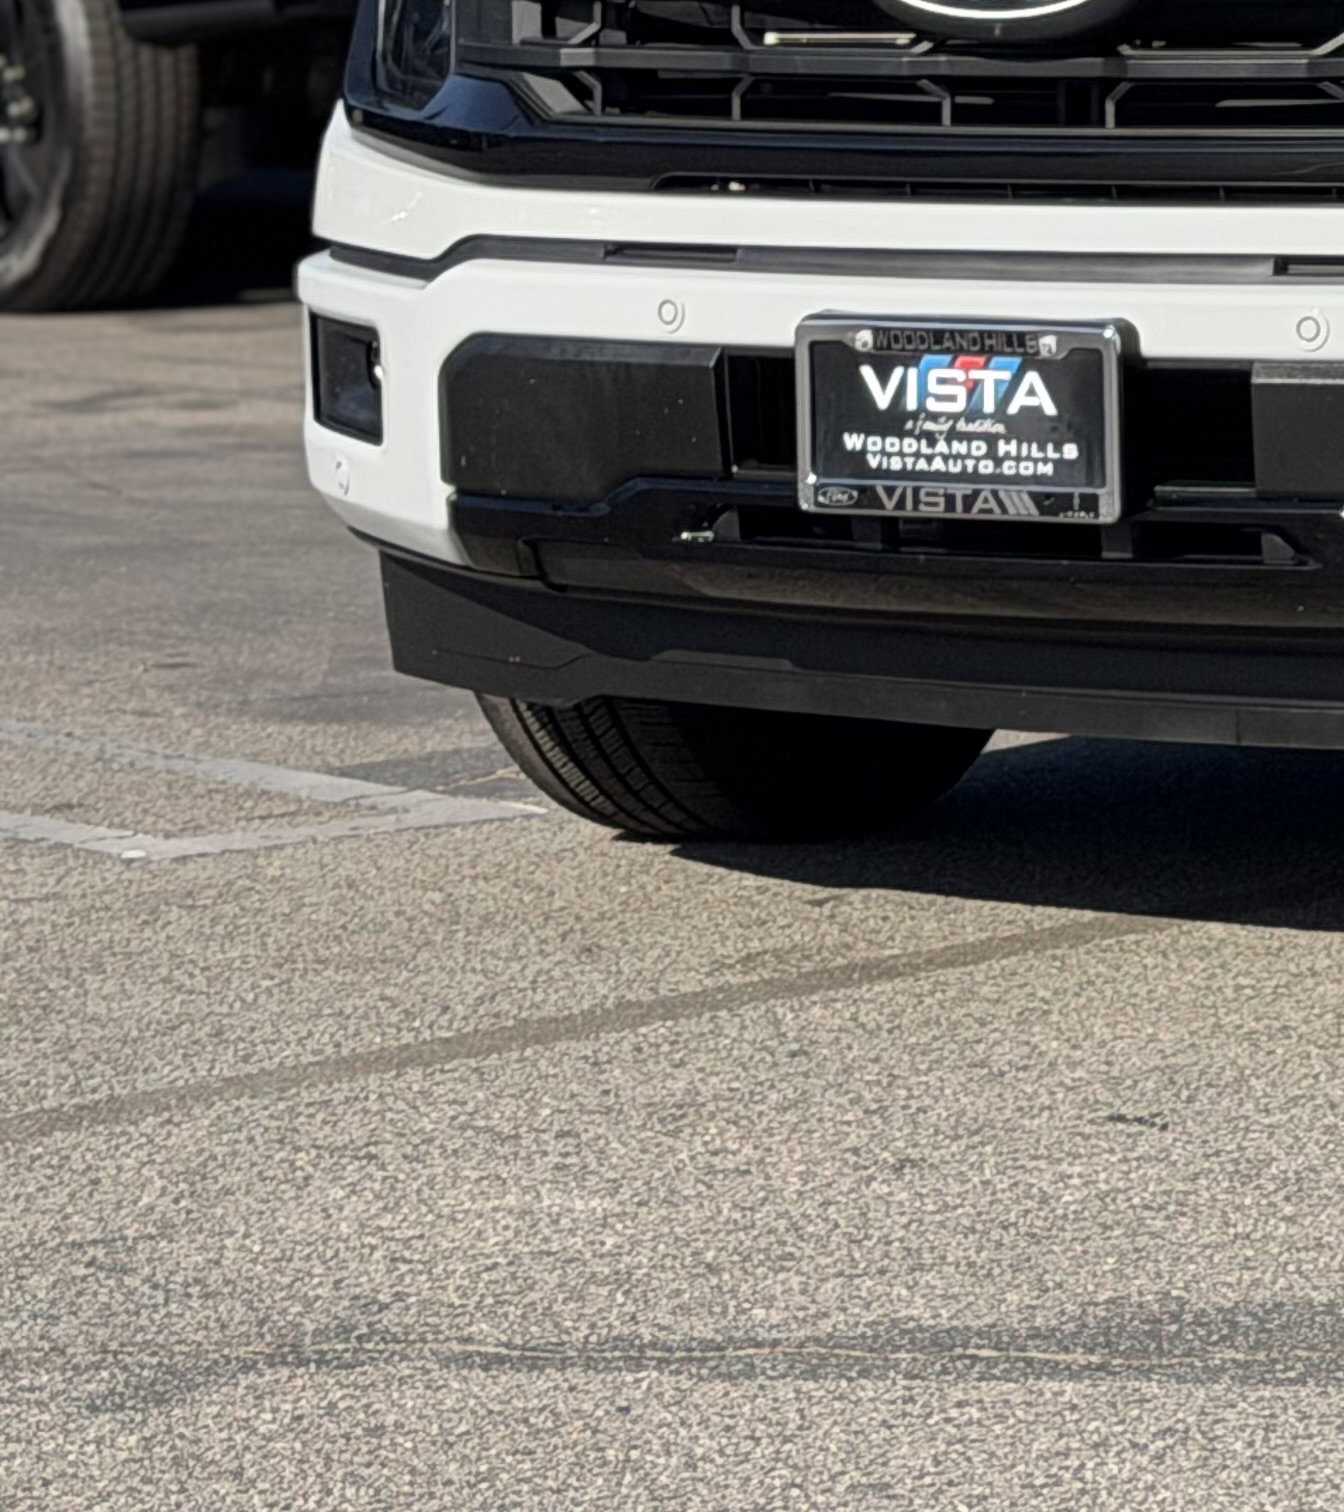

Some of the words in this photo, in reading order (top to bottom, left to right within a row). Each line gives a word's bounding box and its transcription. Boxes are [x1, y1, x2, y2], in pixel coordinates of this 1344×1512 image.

[876, 329, 982, 352] WOODLAND
[983, 332, 1039, 354] HILLS
[859, 364, 1058, 416] VISTA
[842, 432, 988, 456] WOODLAND
[998, 439, 1080, 460] HILLS
[875, 484, 1002, 516] VISTA
